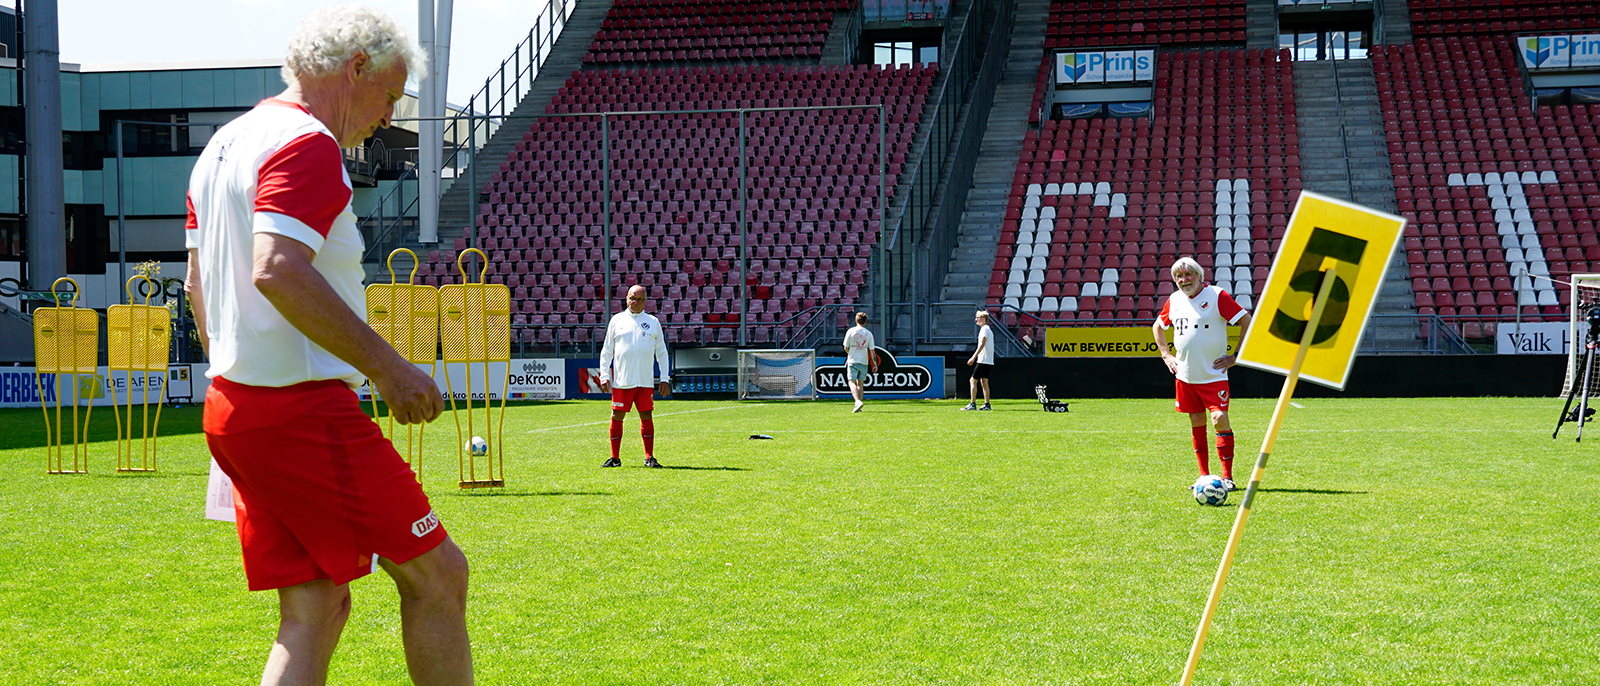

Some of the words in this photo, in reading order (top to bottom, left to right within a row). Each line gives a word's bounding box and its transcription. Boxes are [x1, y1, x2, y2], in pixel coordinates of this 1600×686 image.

[1089, 53, 1149, 71] Prins
[1268, 226, 1368, 345] 5
[1050, 343, 1077, 352] WAT
[1080, 343, 1140, 352] BEWEEGT
[1141, 343, 1174, 352] JO?
[1507, 332, 1552, 351] Valk
[180, 370, 188, 379] 5
[820, 372, 922, 387] NAOLEON
[0, 372, 57, 402] ERBEEK
